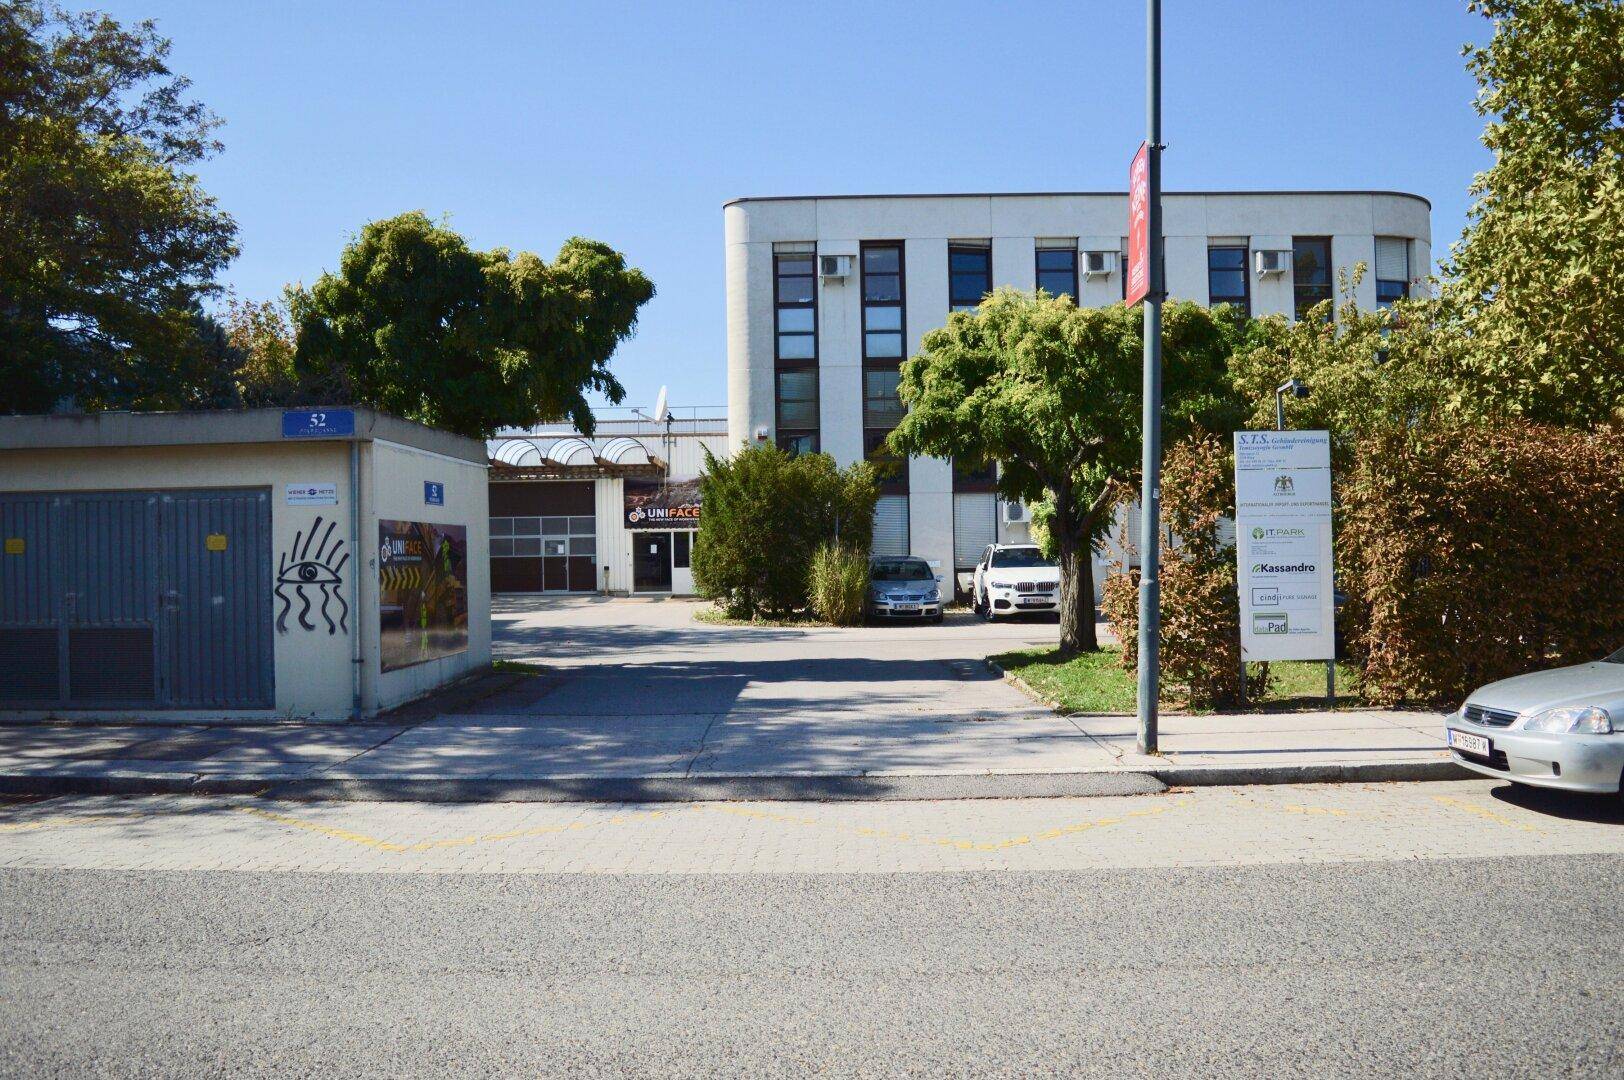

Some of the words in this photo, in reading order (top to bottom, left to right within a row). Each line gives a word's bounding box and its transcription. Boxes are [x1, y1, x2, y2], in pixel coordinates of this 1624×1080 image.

[309, 413, 326, 427] 52
[1239, 434, 1269, 445] S.T.S.
[648, 508, 700, 518] UNIFACE
[1265, 528, 1305, 536] IT.PARK
[392, 540, 422, 555] UNIFACE
[1261, 562, 1315, 573] Kassandro
